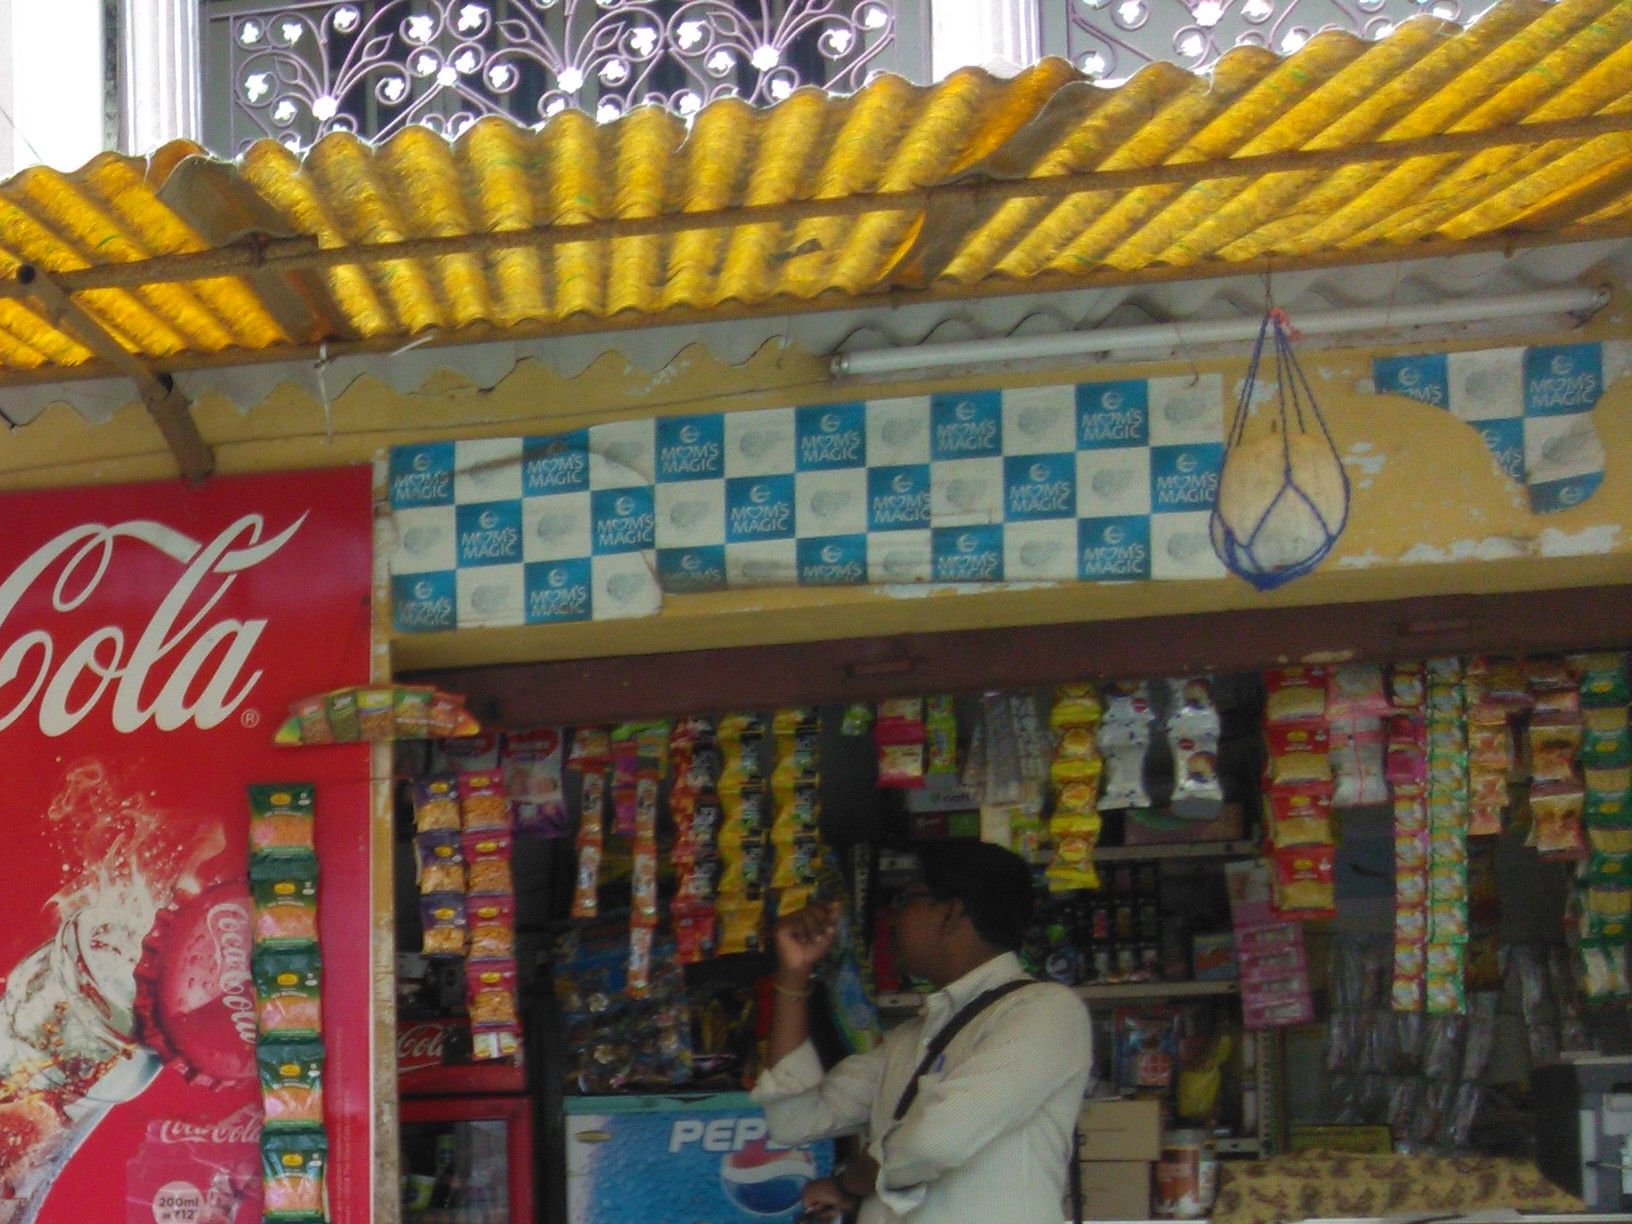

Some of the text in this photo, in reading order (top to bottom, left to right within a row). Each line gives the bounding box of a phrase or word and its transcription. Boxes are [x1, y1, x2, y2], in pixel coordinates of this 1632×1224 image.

[1531, 389, 1593, 406] MAGIC
[1084, 424, 1140, 440] MAGIC
[938, 435, 994, 451] MAGIC
[803, 447, 858, 462] MAGIC
[665, 457, 717, 473] MAGIC
[529, 470, 583, 487] MAGIC
[395, 484, 450, 500] MAGIC
[1159, 487, 1215, 502] MAGIC
[1011, 497, 1068, 512] MAGIC
[875, 507, 931, 523] MAGIC
[733, 518, 788, 534] MAGIC
[599, 530, 652, 545] MAGIC
[463, 543, 516, 559] MAGIC
[1086, 560, 1142, 574] MAGIC
[532, 600, 585, 616] MAGIC
[158, 1196, 200, 1208] 200ml
